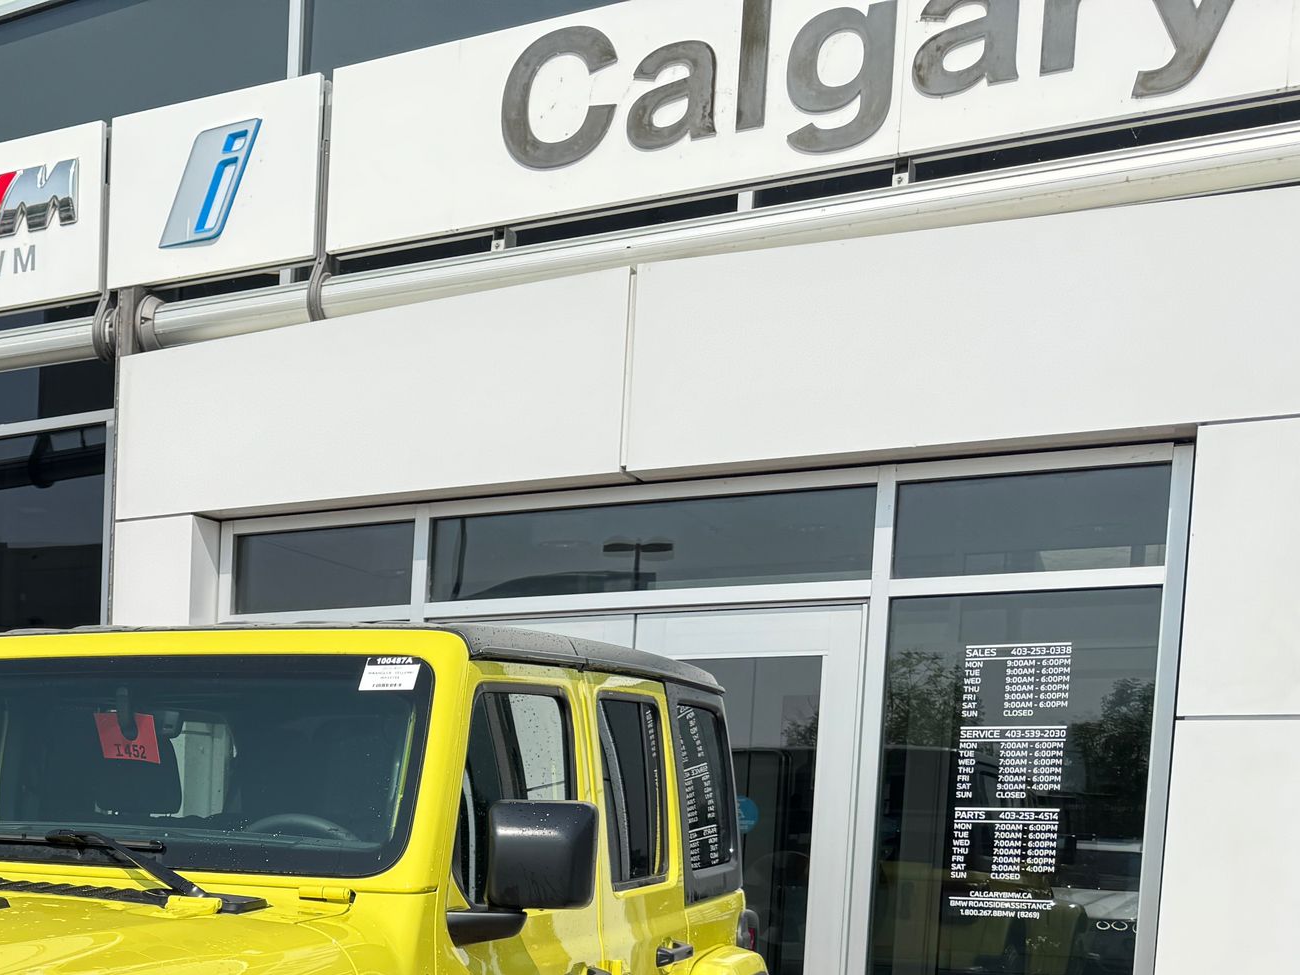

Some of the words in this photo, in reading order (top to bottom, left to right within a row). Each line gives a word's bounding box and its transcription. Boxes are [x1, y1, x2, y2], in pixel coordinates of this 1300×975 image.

[13, 244, 36, 274] M
[966, 649, 997, 657] SALES
[1011, 646, 1072, 655] 403-253-0338
[376, 657, 413, 665] 100487A
[1042, 658, 1071, 666] 6:00PM
[960, 730, 1000, 738] SERVICE
[1005, 729, 1066, 738] 403-539-2030
[1035, 741, 1064, 749] 6:00PM
[954, 811, 986, 819] PARTS
[999, 812, 1059, 820] 403-253-4514
[1026, 857, 1055, 865] 6:00PM
[1026, 865, 1055, 873] 4:00PM
[969, 891, 1032, 899] CALGARYBMW.CA
